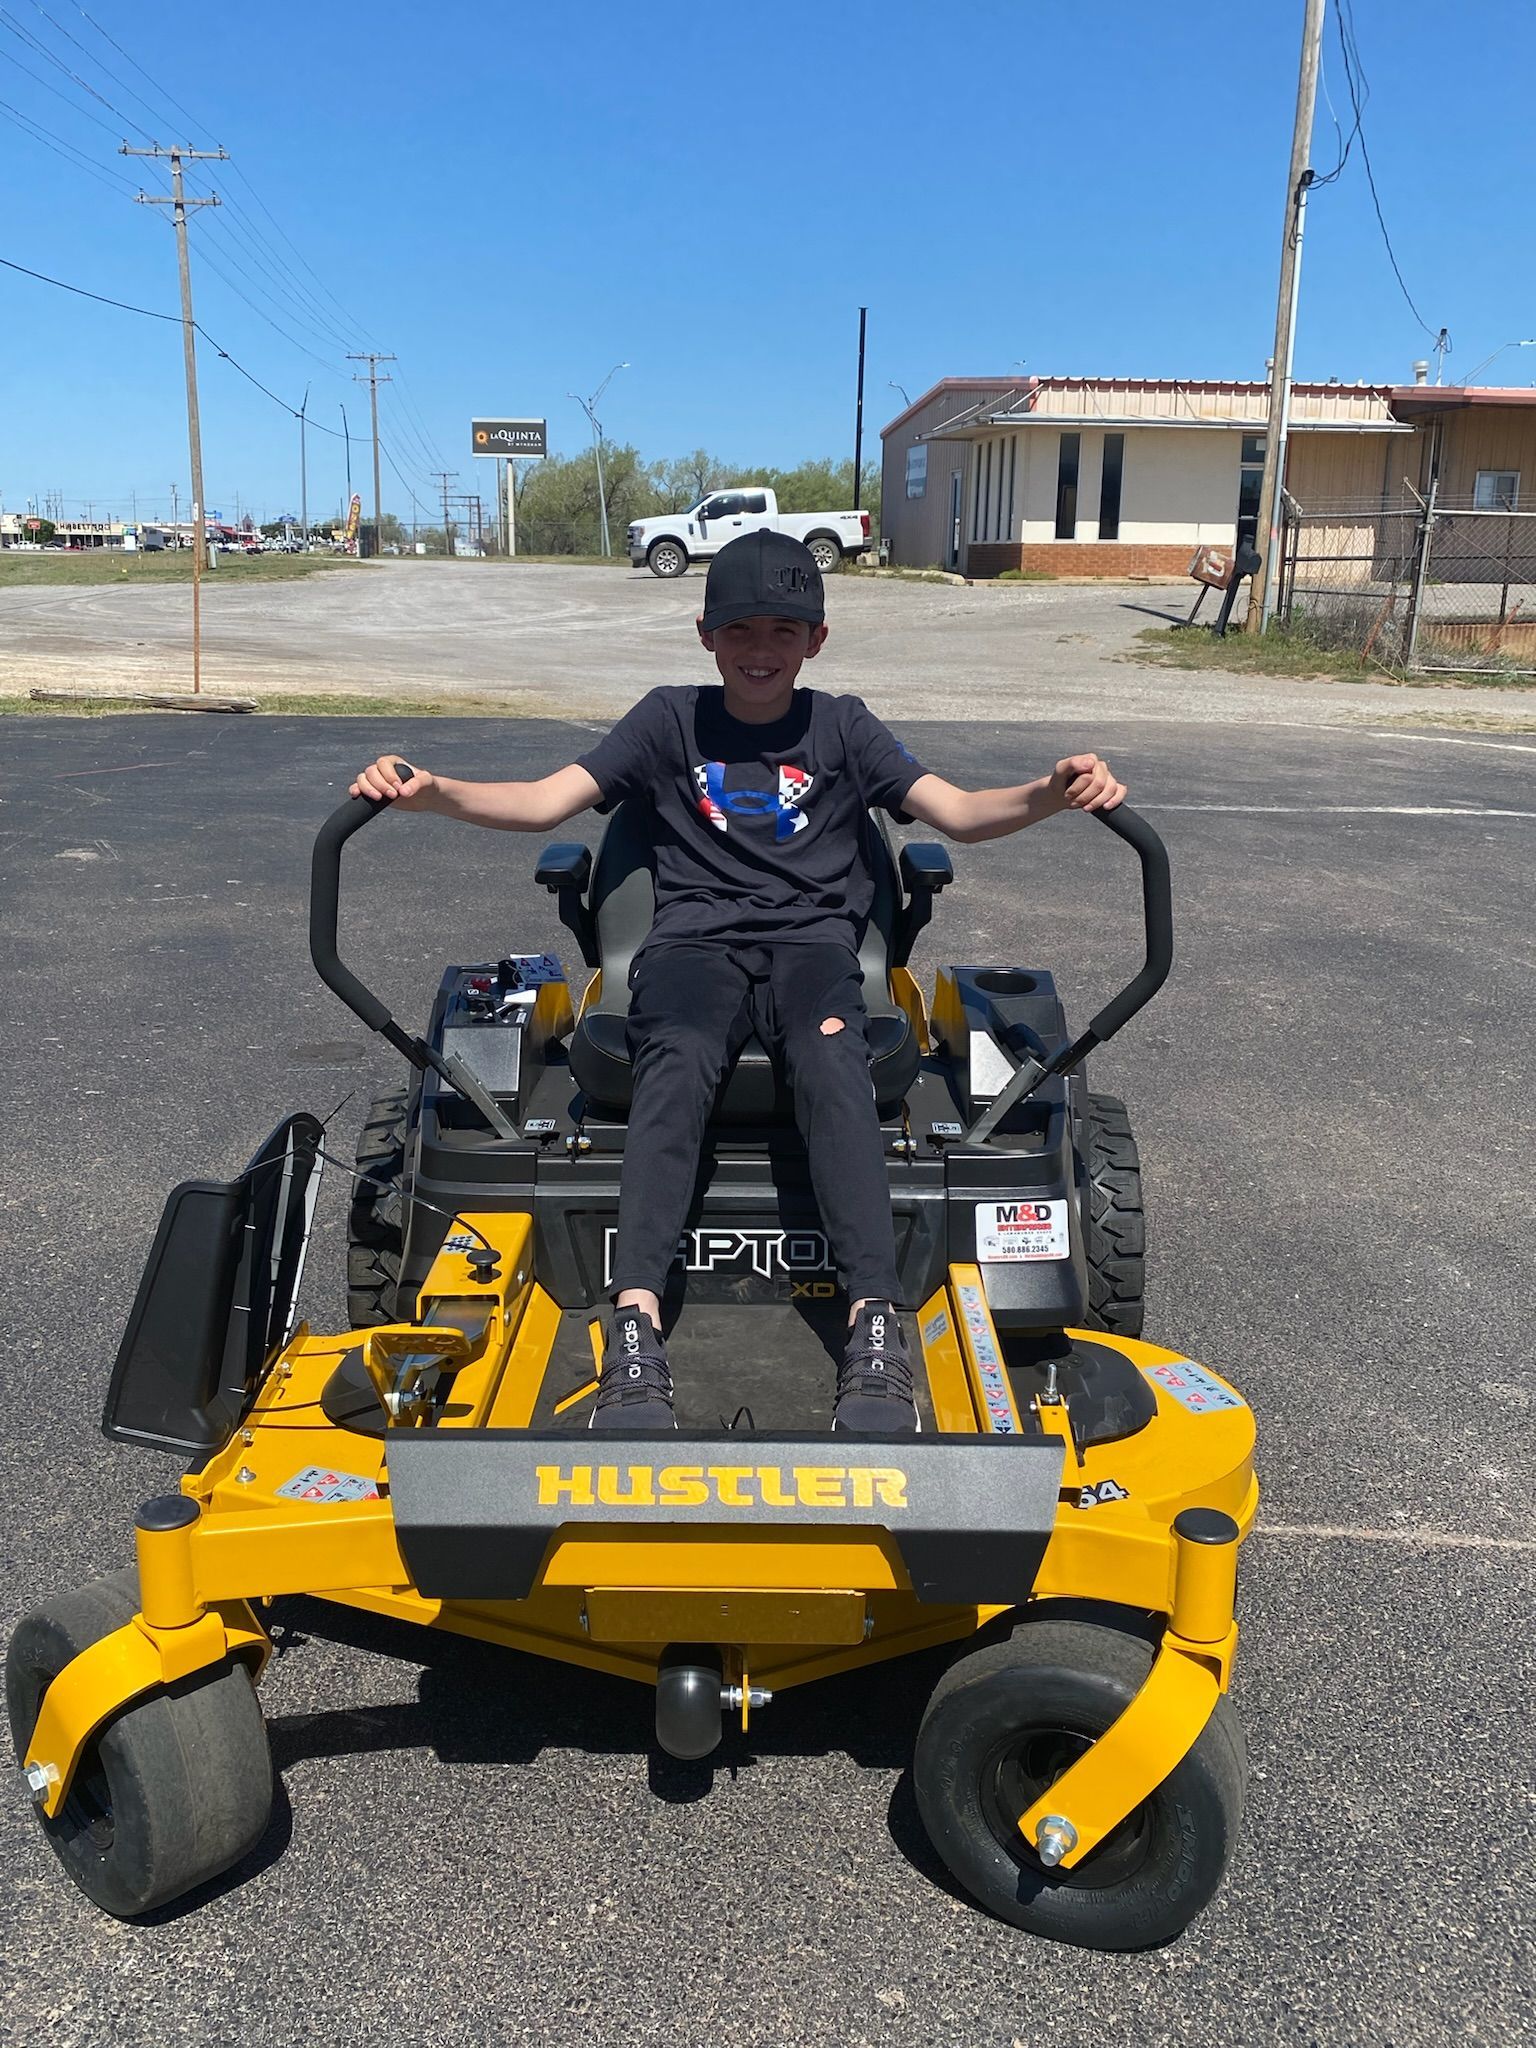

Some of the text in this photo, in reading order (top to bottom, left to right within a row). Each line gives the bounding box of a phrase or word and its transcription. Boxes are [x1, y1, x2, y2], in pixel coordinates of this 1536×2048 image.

[996, 1204, 1052, 1222] M&D
[604, 1228, 837, 1288] PTO
[623, 1319, 642, 1379] aidas
[868, 1314, 885, 1371] aidas
[535, 1465, 908, 1508] HUSTLER
